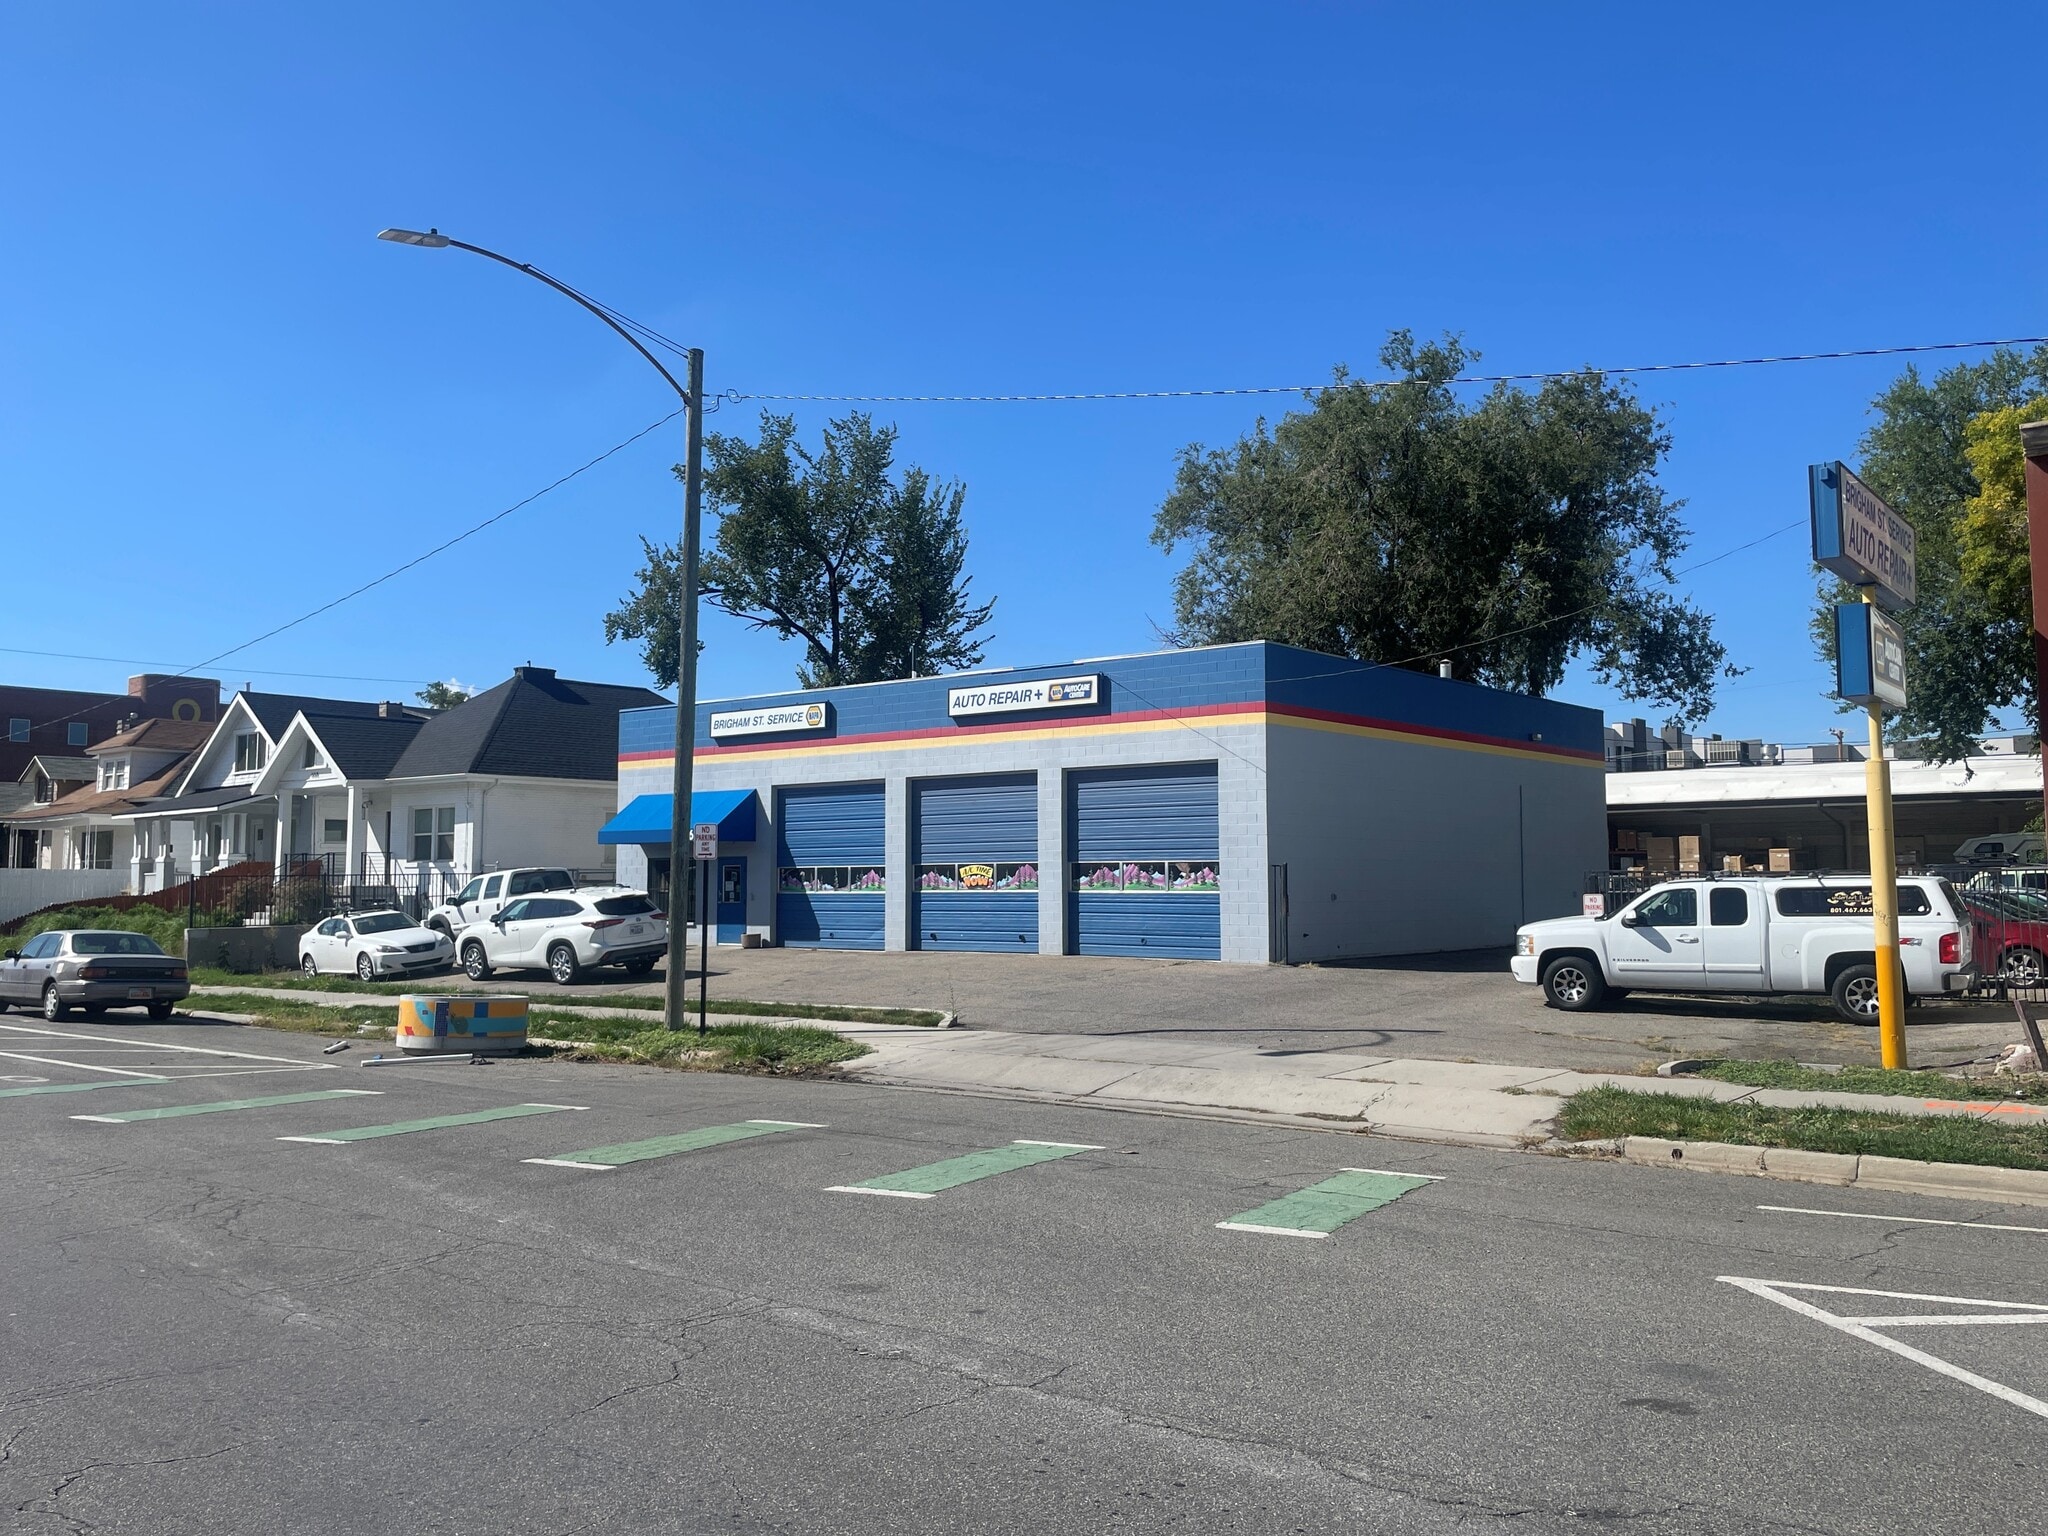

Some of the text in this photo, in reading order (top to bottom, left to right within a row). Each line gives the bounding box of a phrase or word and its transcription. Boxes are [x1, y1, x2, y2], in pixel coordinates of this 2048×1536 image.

[1845, 480, 1912, 554] BRIGHAM ST. SERVICE
[1849, 518, 1875, 565] AUTO
[952, 693, 986, 709] AUTO
[713, 712, 804, 730] BRIGHAM ST. SERVICE
